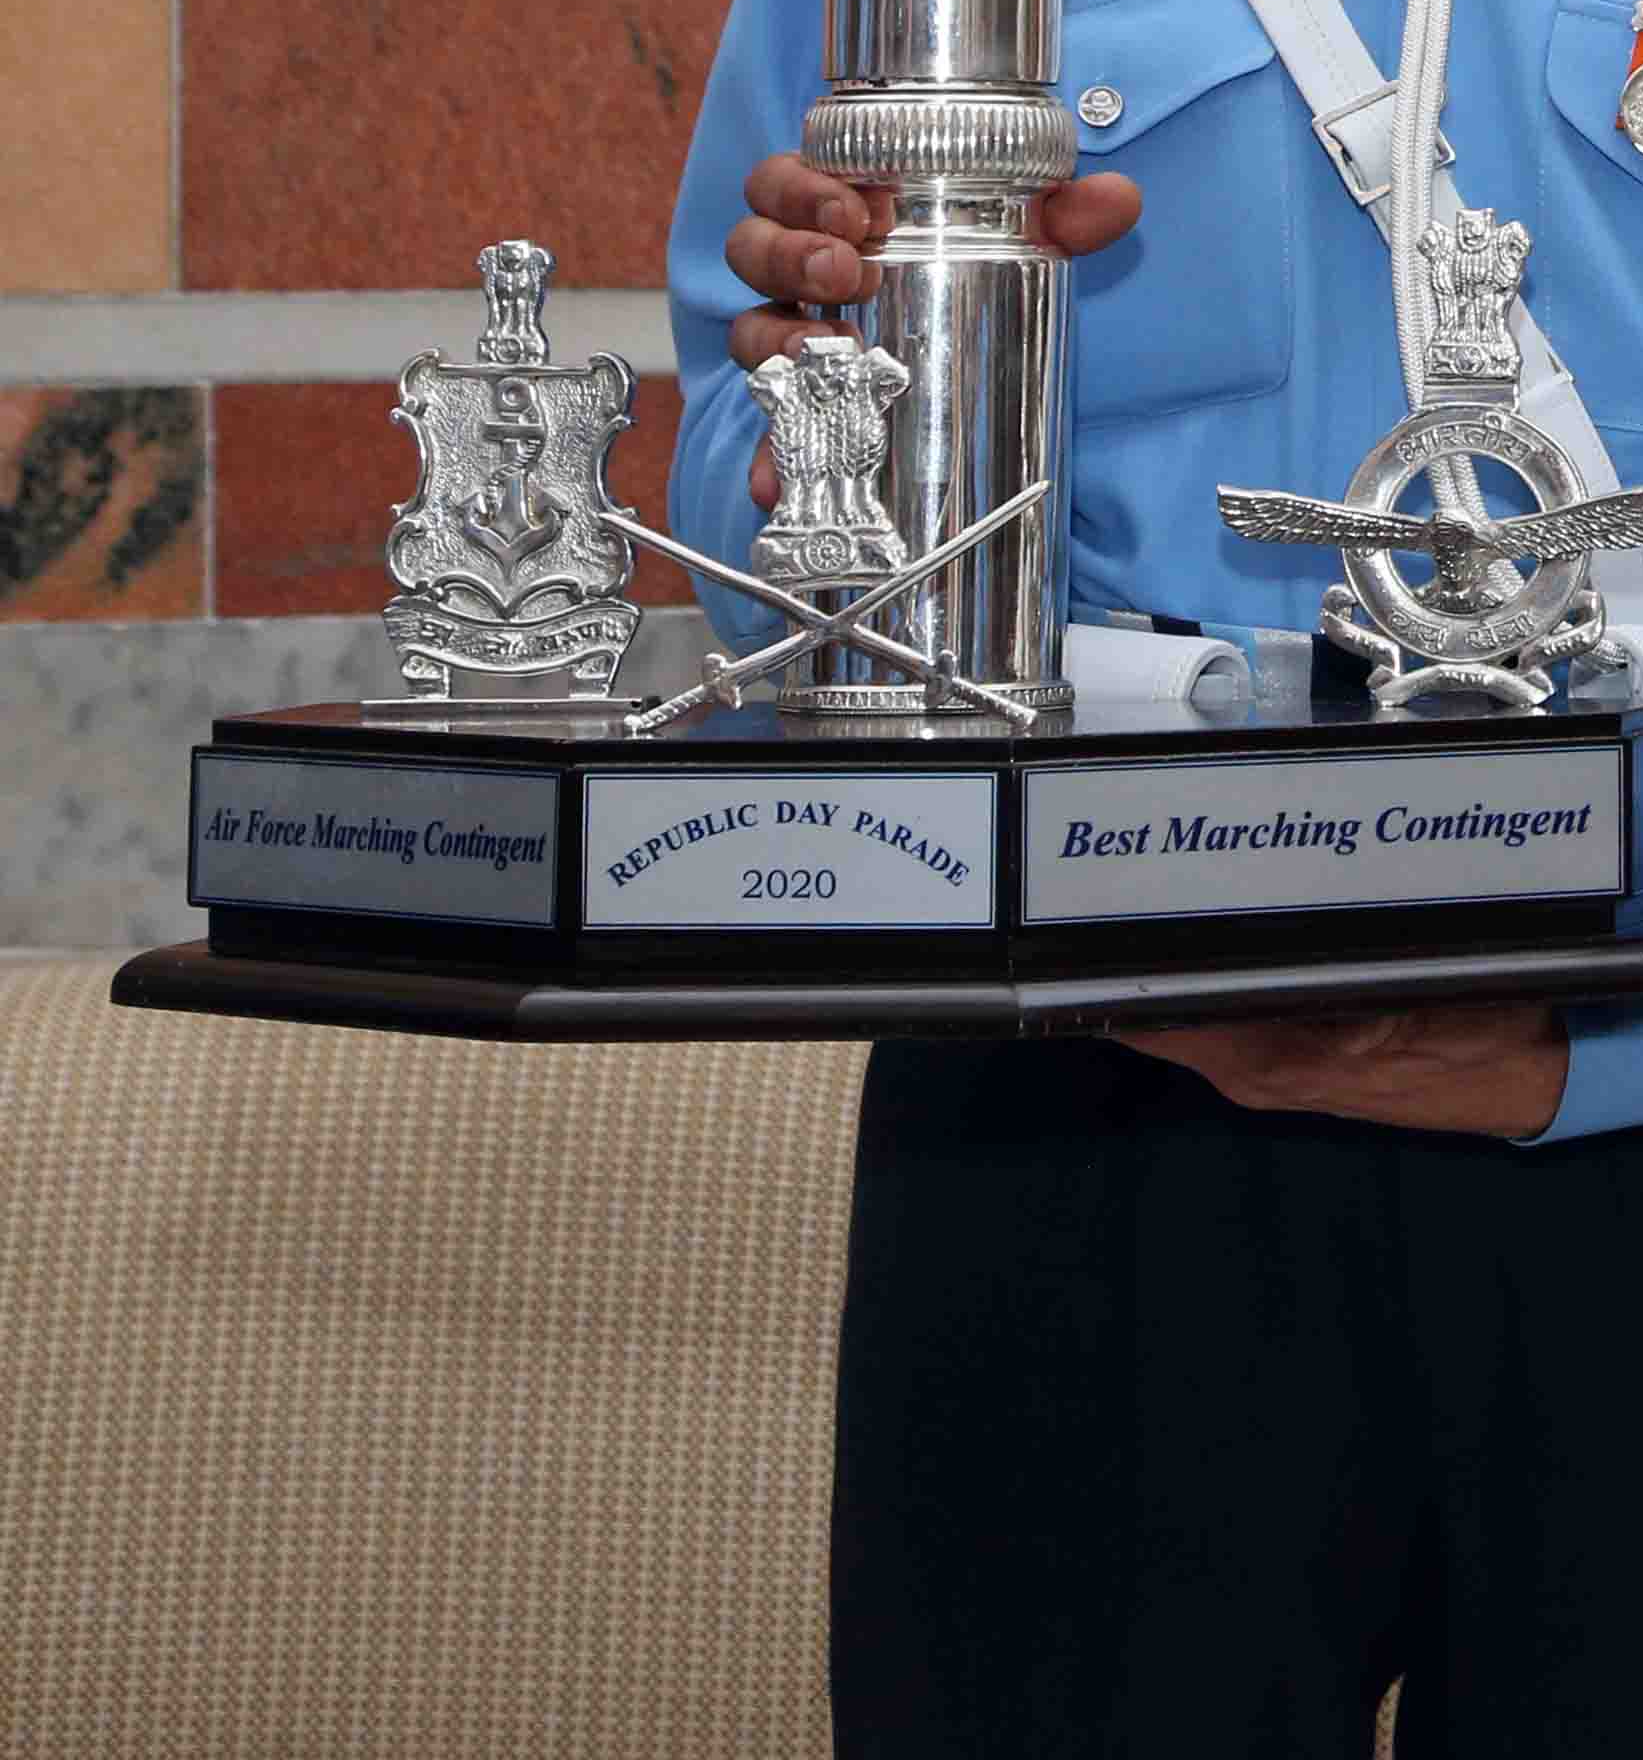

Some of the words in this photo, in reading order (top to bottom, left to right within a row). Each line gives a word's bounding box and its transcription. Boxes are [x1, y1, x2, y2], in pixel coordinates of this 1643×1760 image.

[205, 807, 241, 843] Air
[243, 810, 307, 848] Force
[311, 813, 419, 865] Marching
[423, 820, 547, 872] Contingent
[607, 803, 760, 889] REPUBLIC
[774, 800, 840, 828] DAY
[853, 810, 972, 889] PARADE
[1058, 820, 1153, 858] Best
[1160, 810, 1363, 856] Marching
[1375, 802, 1592, 848] Contingent
[740, 868, 838, 900] 2020
